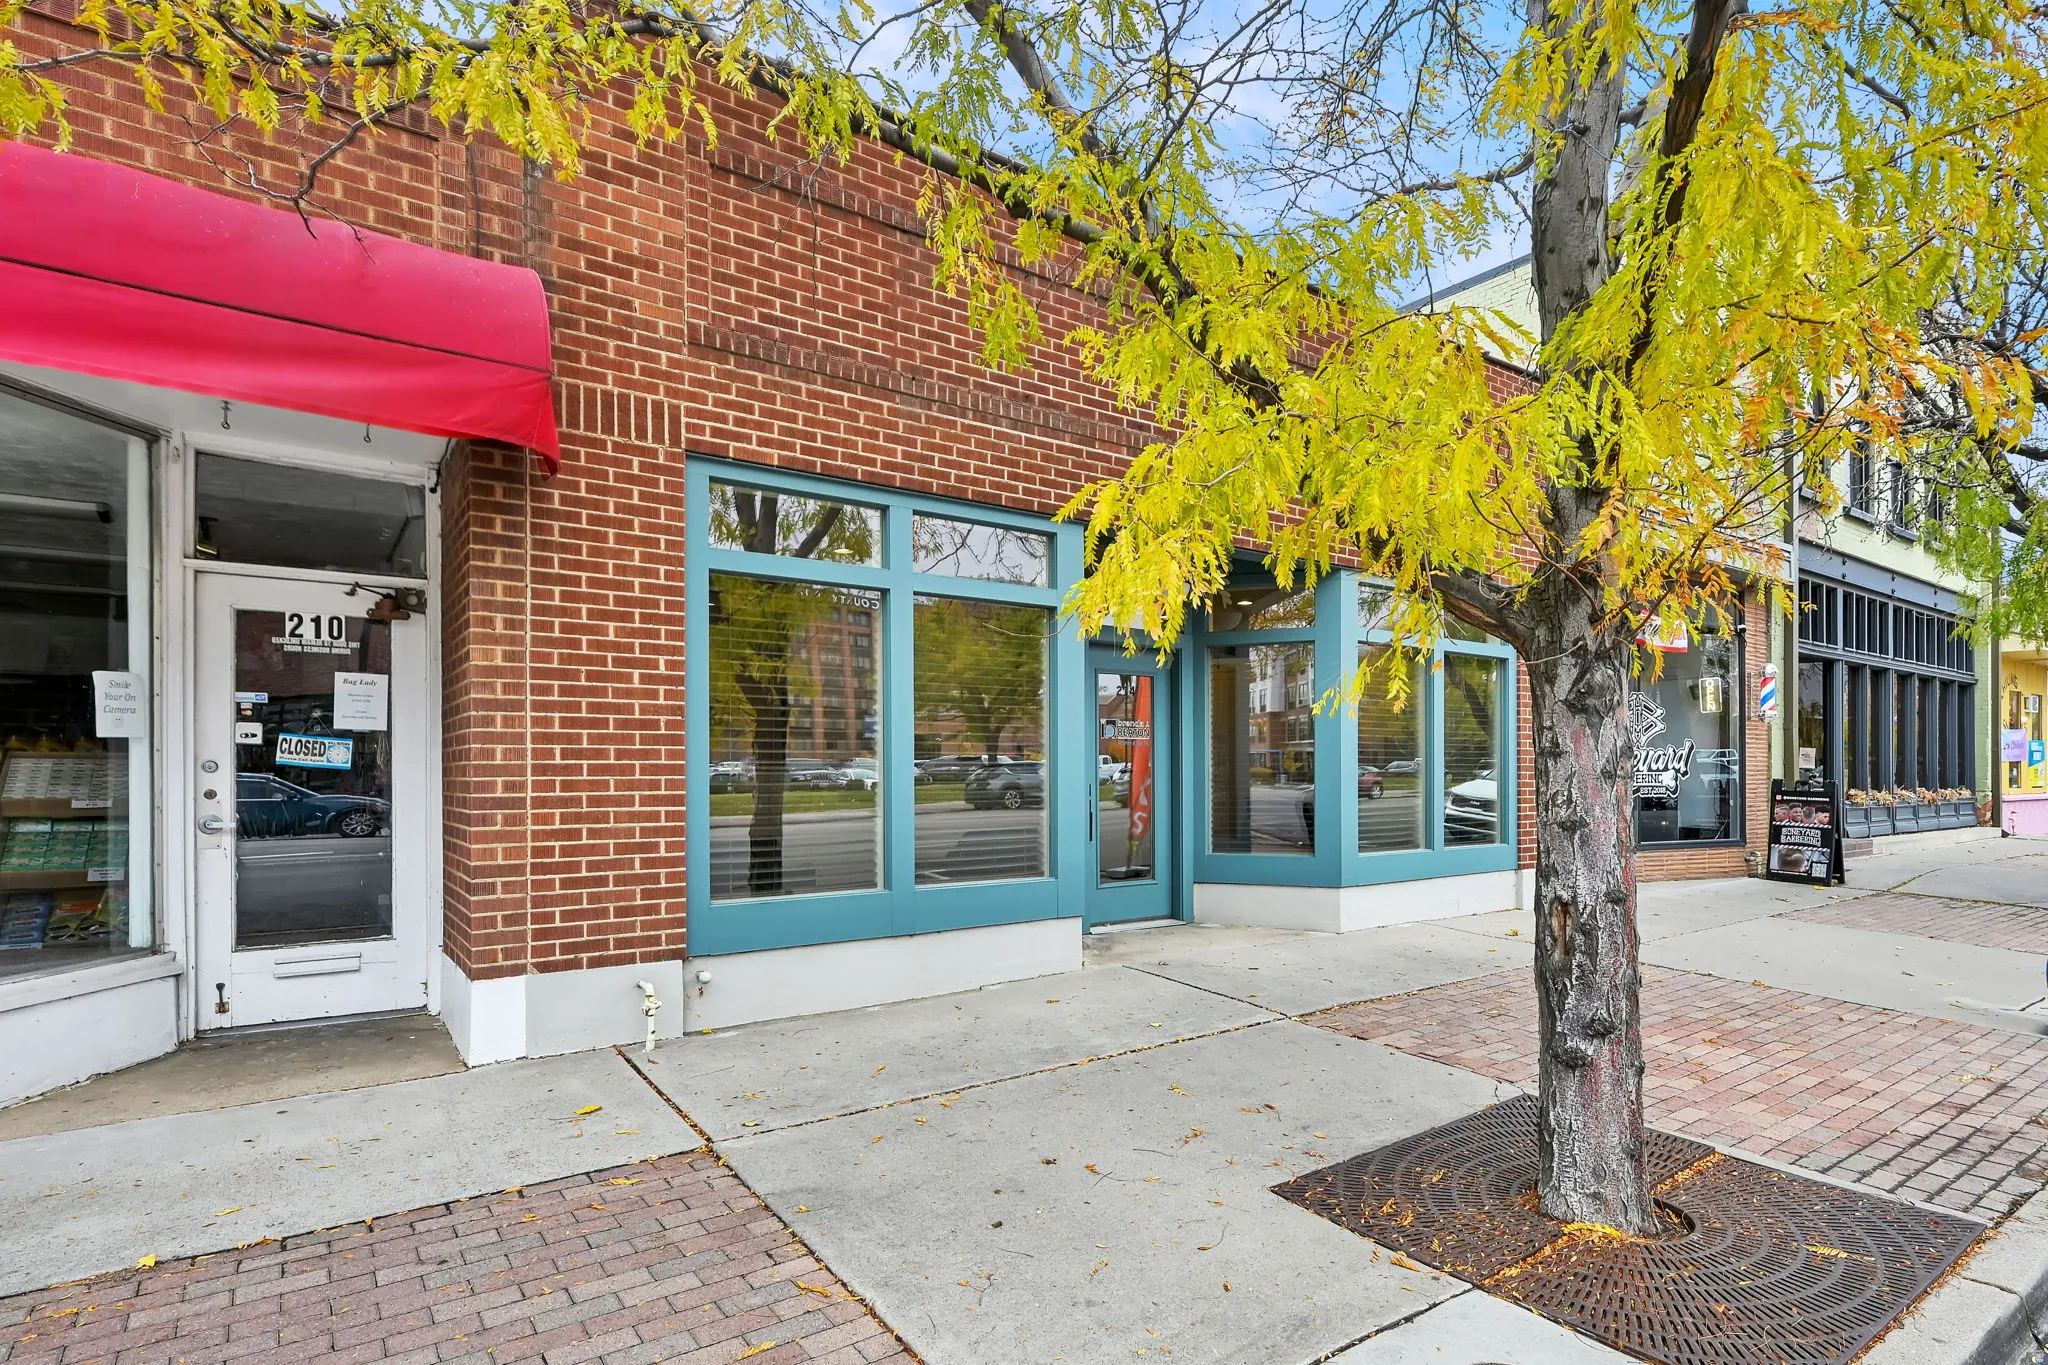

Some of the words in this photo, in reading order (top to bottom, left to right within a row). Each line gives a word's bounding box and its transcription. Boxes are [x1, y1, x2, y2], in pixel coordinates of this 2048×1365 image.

[288, 613, 343, 640] 210
[109, 679, 131, 689] Smile
[359, 679, 378, 687] Lady
[104, 691, 123, 701] Your
[124, 692, 137, 702] On
[1705, 679, 1716, 711] OPEN
[103, 704, 136, 714] Camera
[279, 737, 327, 757] CLOSED
[1633, 740, 1692, 773] eyard
[1635, 772, 1663, 785] ERING
[1640, 787, 1653, 795] EST
[1781, 827, 1822, 838] BONEYARD
[1780, 835, 1822, 847] BARBERING
